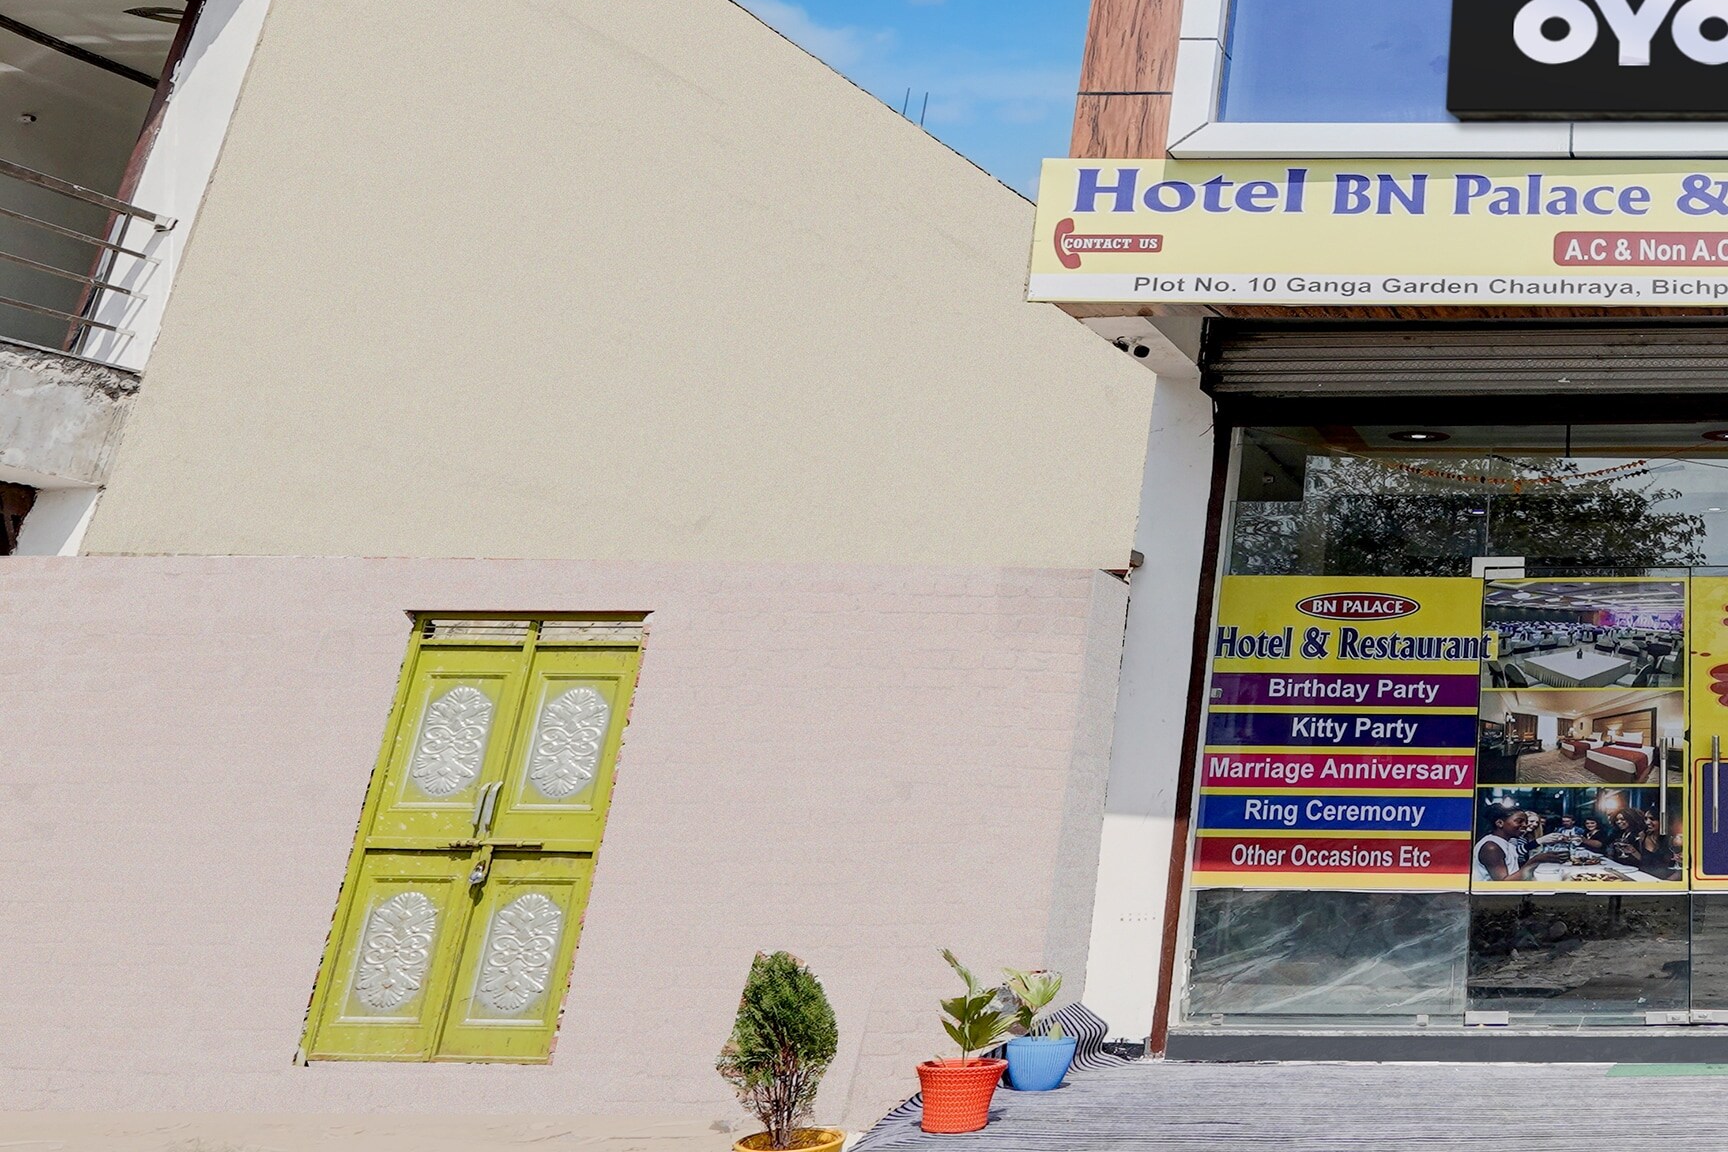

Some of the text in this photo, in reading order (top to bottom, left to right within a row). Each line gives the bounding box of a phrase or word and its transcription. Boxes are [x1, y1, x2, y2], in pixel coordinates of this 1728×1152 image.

[1072, 167, 1308, 214] Hotel
[1332, 173, 1431, 215] BN
[1452, 173, 1651, 216] Palace
[1064, 238, 1158, 249] CONTACT US
[1564, 239, 1607, 261] A.C
[1614, 239, 1631, 260] &
[1639, 239, 1684, 260] Non
[1133, 276, 1185, 293] Plot
[1194, 277, 1237, 293] No.
[1248, 277, 1277, 293] 10
[1286, 277, 1372, 297] Ganga
[1381, 277, 1480, 295] Garden
[1489, 278, 1642, 299] Chauhraya,
[1311, 600, 1404, 614] BN PALACE
[1214, 626, 1492, 661] Hotel & Restaurant
[1268, 678, 1440, 703] Birthday Party
[1291, 717, 1418, 743] Kitty Party
[1209, 757, 1468, 785] Marriage Anniversary
[1244, 799, 1426, 826] Ring Ceremony
[1231, 844, 1431, 867] Other Occasions Etc
